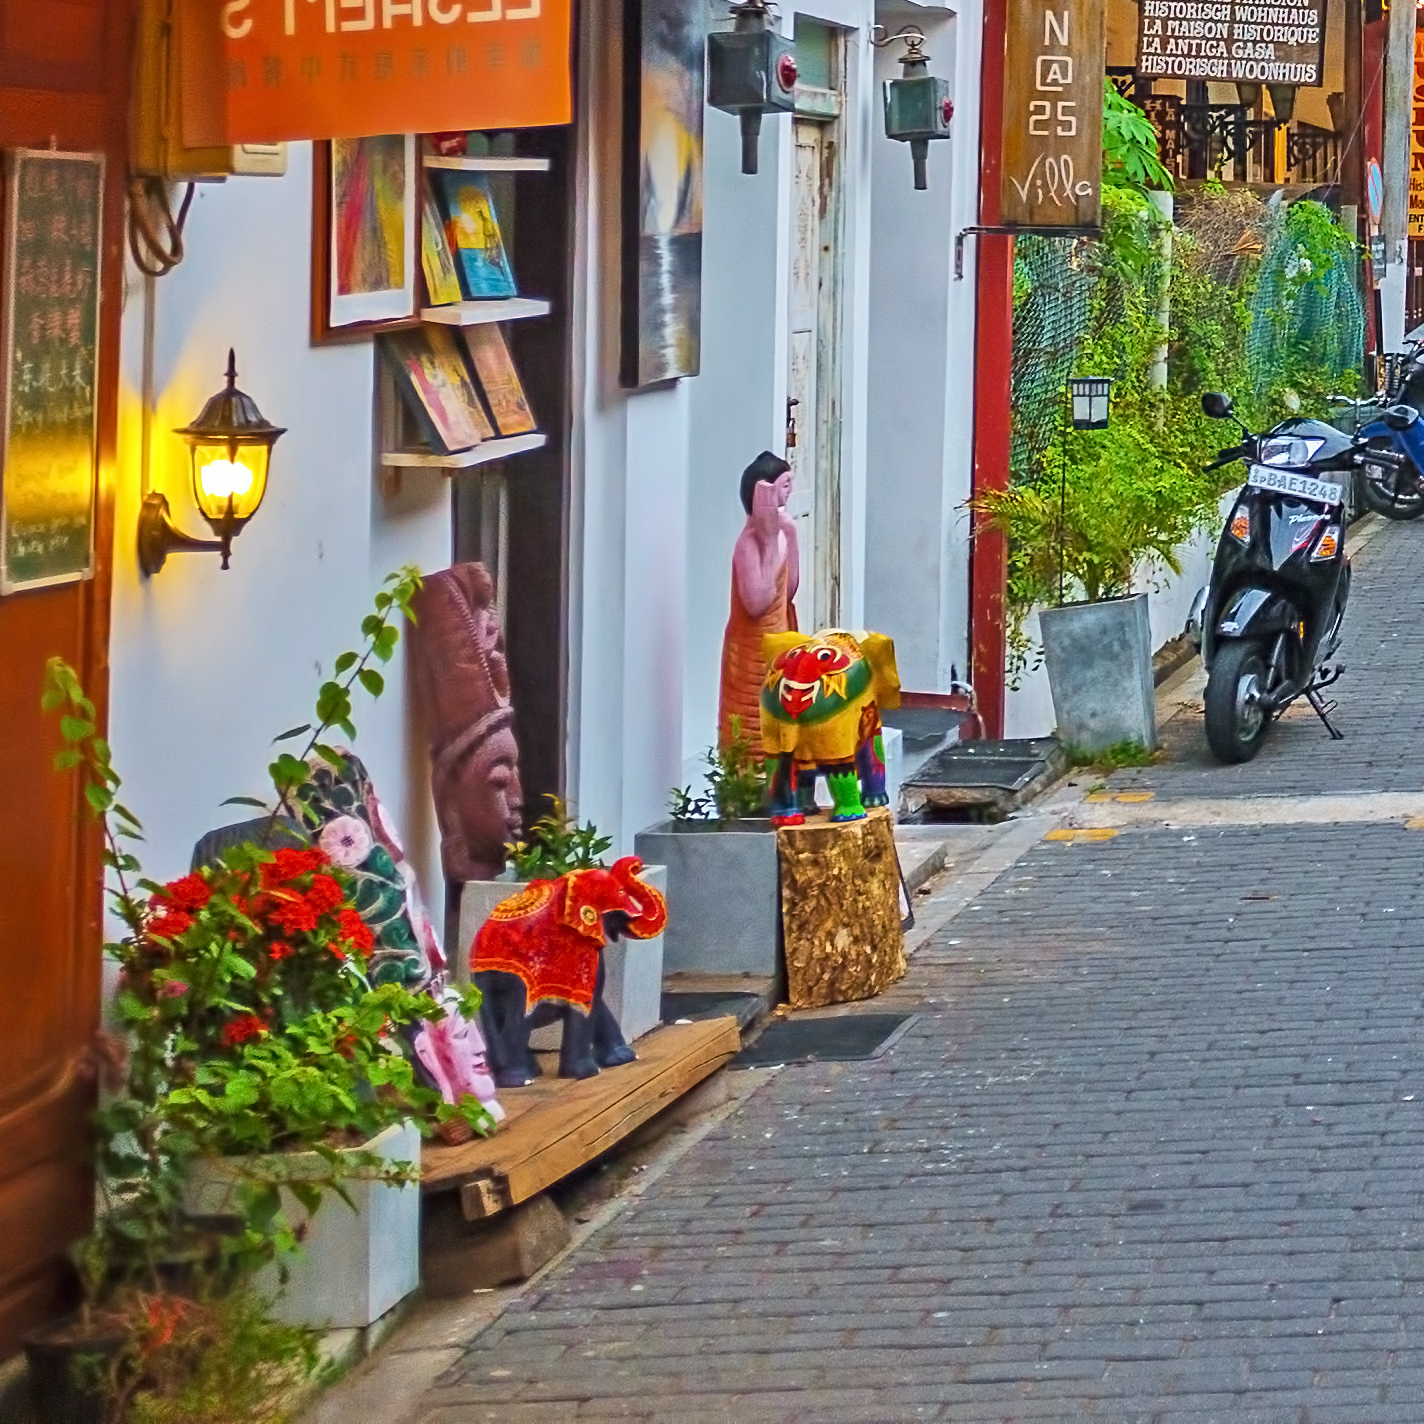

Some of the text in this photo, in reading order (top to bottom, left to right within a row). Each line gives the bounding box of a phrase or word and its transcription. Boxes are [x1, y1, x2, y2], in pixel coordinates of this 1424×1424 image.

[1234, 5, 1318, 25] WOHNHAUS
[1143, 19, 1320, 46] LA MAISON HISTORIQUE
[1231, 61, 1317, 83] WOONHUIS
[1029, 100, 1077, 136] 25
[1009, 153, 1092, 206] Villa
